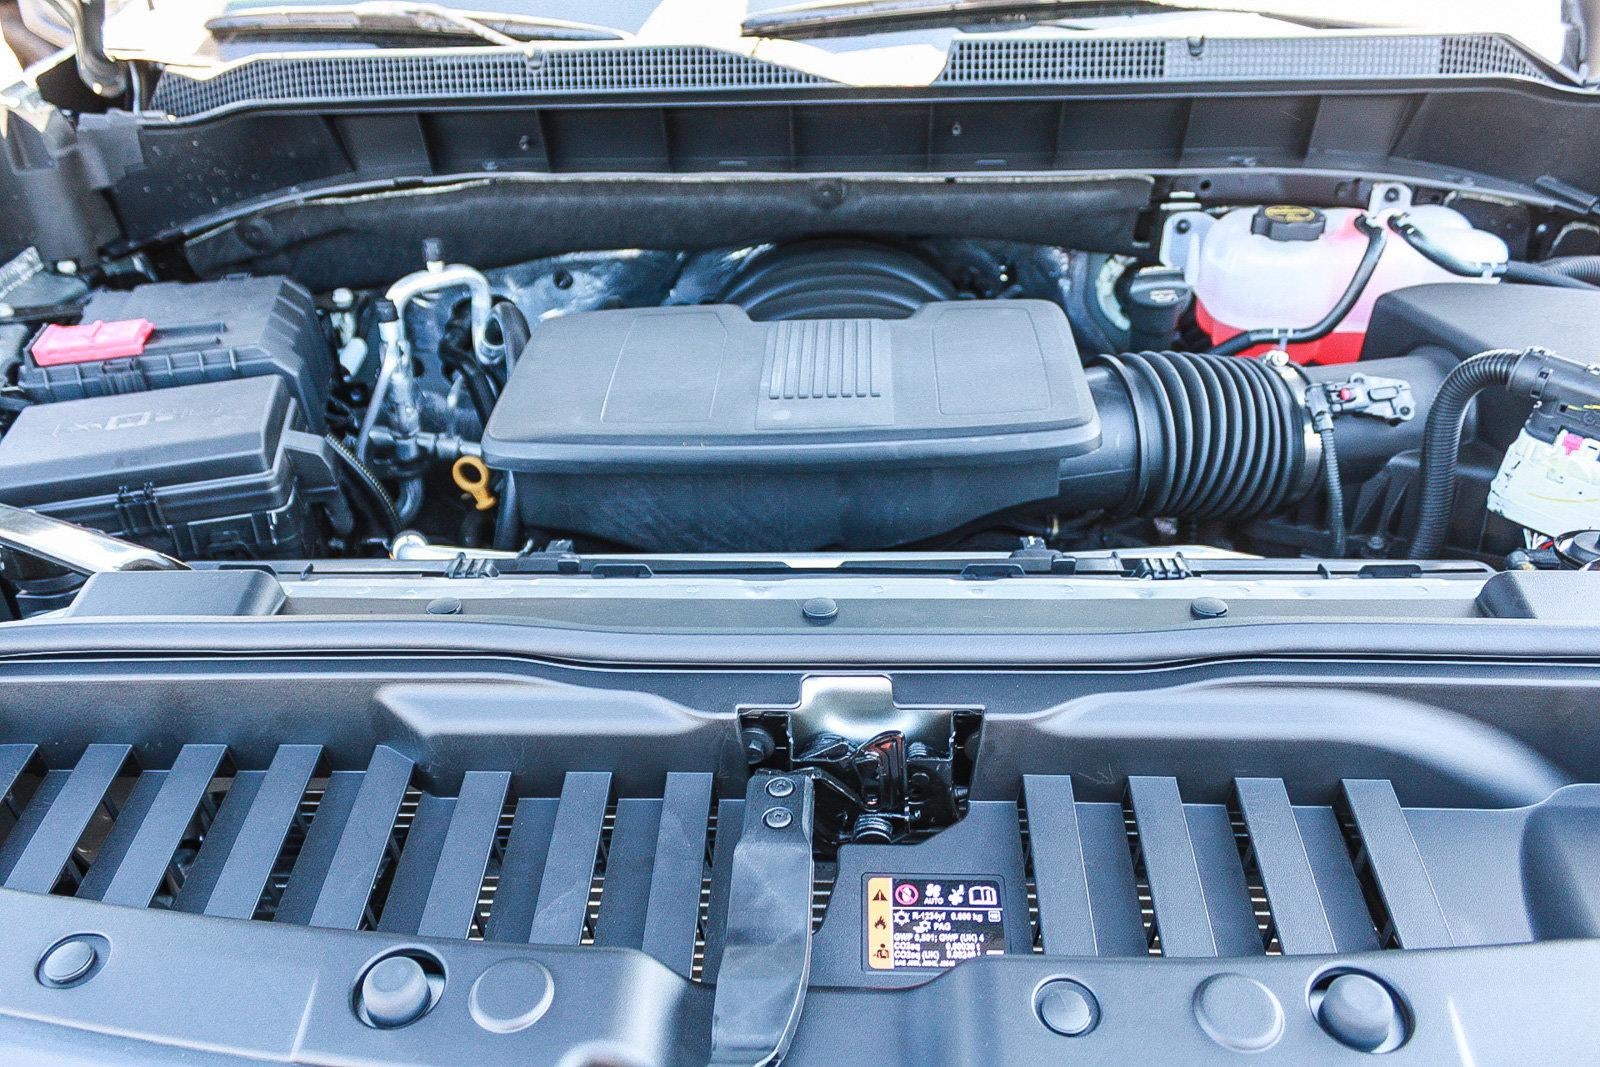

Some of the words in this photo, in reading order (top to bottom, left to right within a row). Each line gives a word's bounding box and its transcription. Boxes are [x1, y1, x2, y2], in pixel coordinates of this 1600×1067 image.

[924, 897, 944, 905] AUTO
[973, 912, 983, 922] kg
[933, 922, 951, 931] PAG
